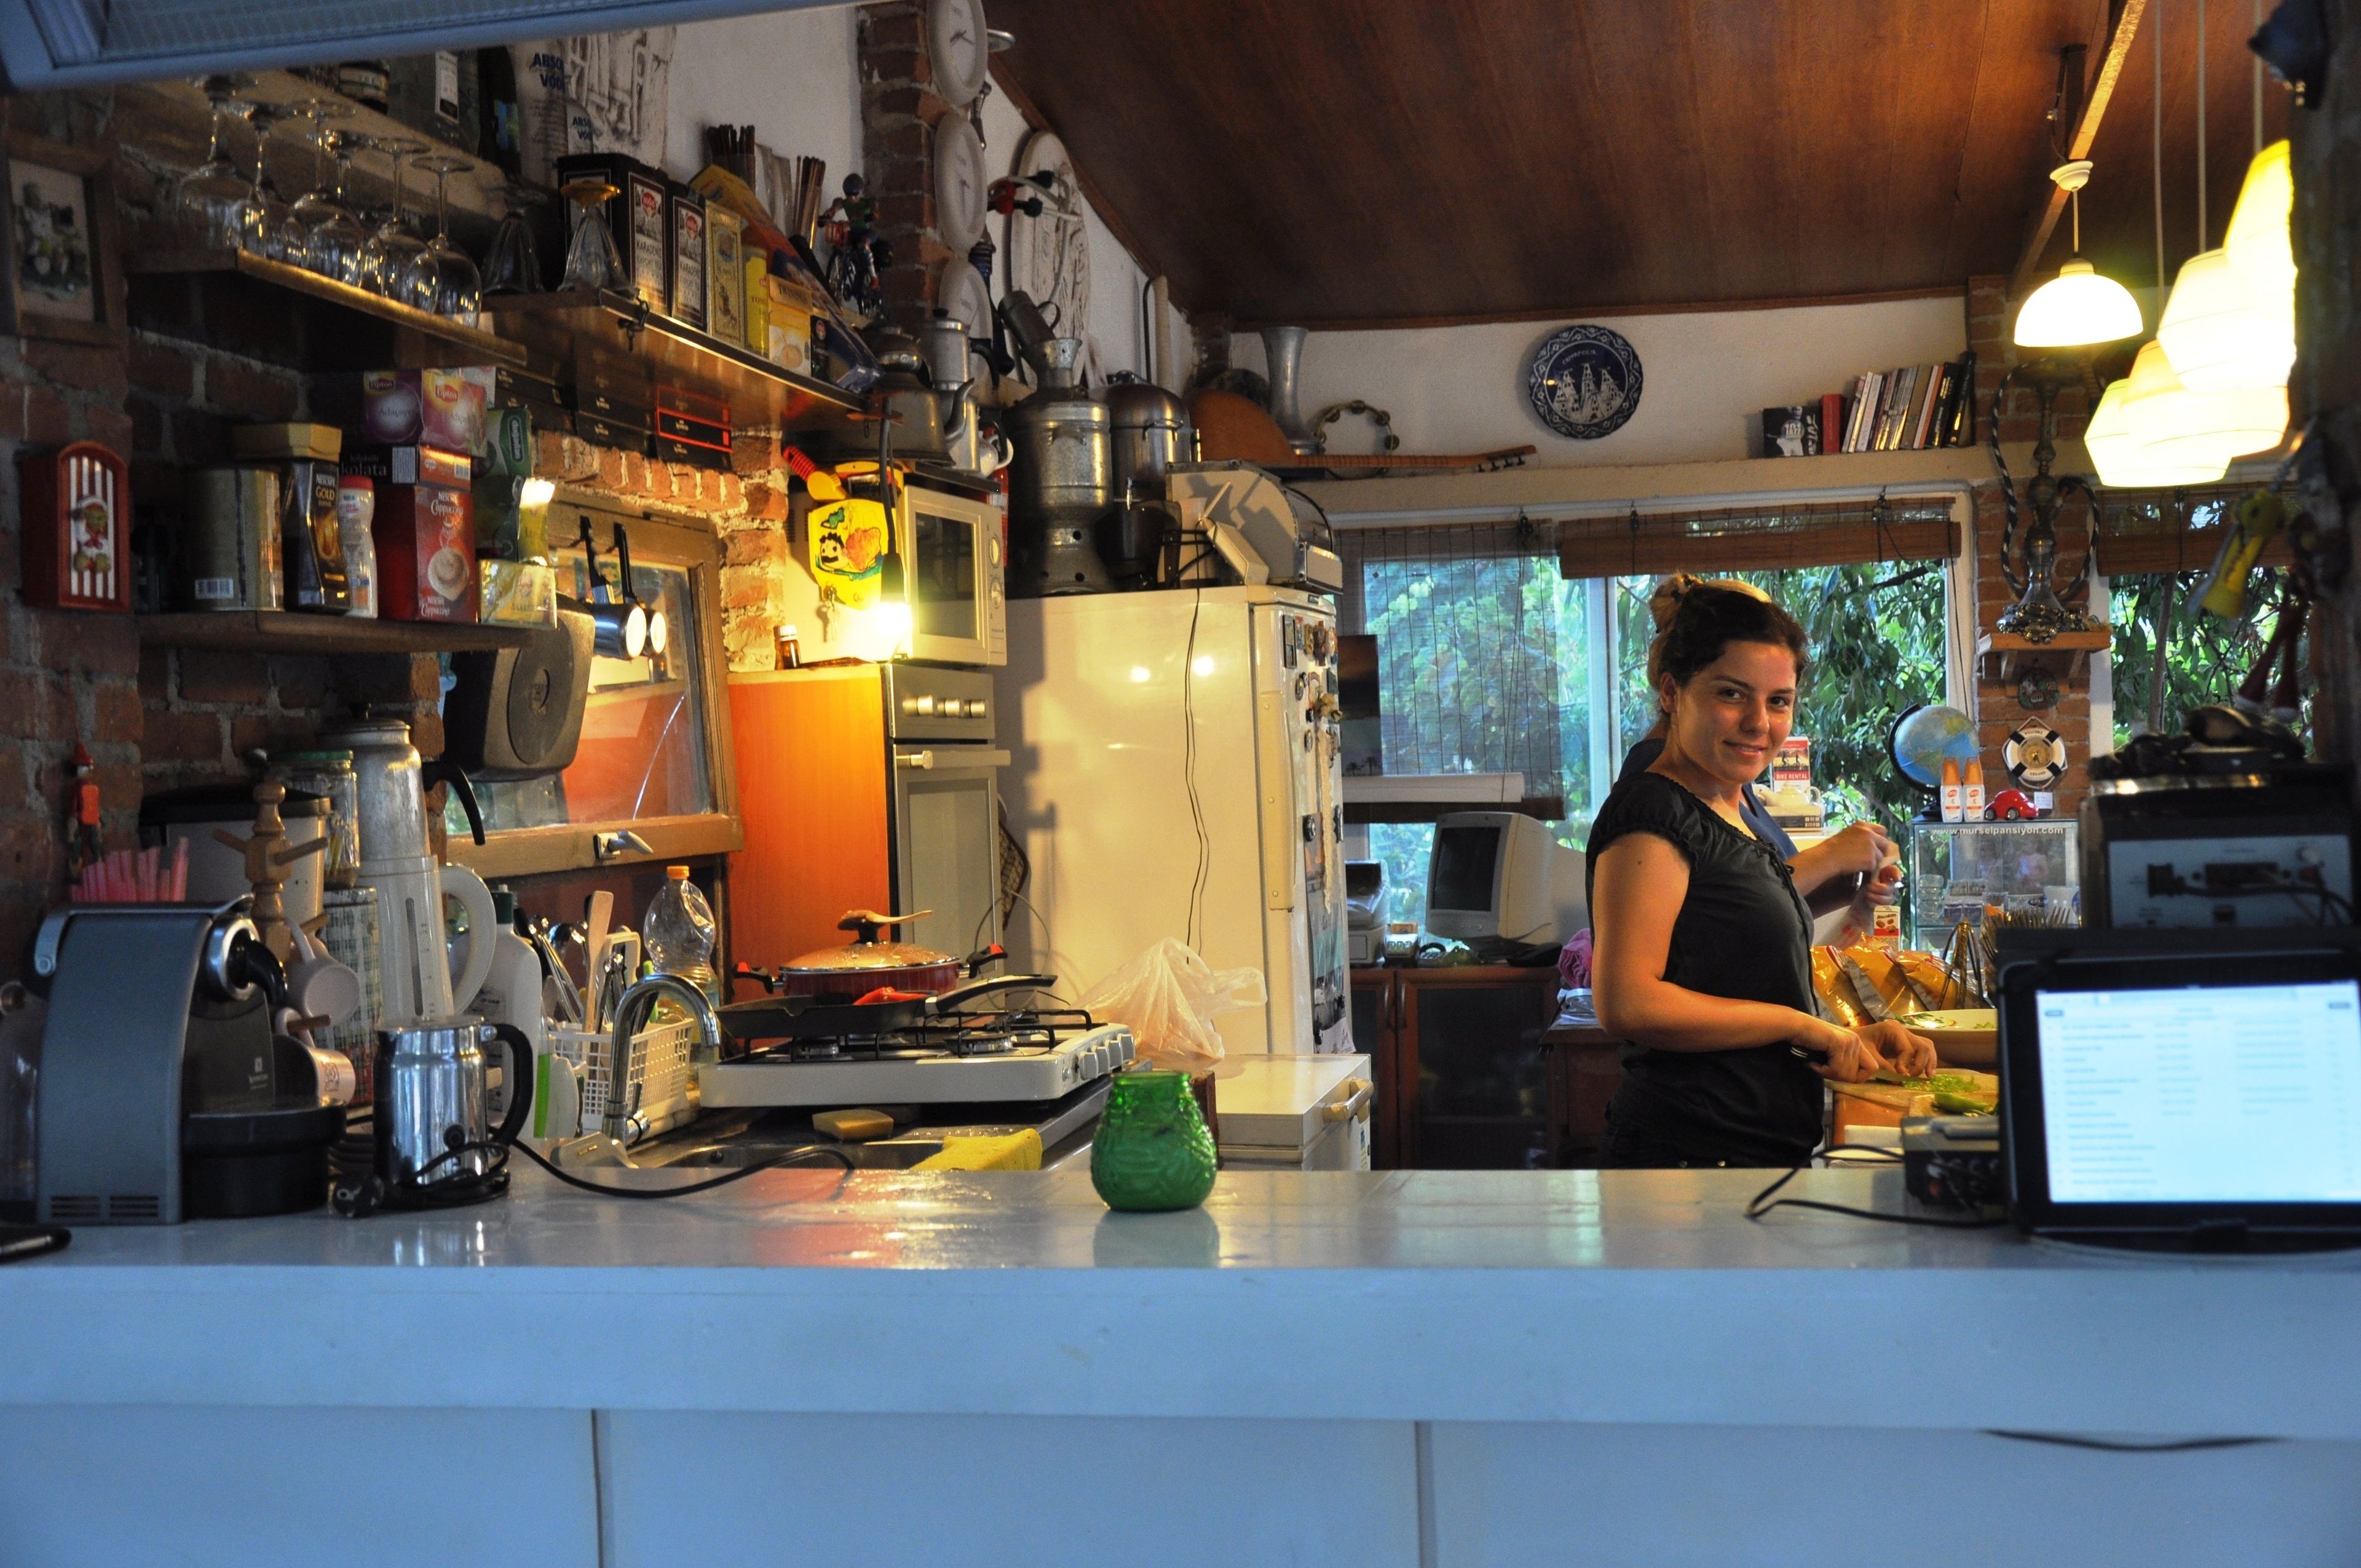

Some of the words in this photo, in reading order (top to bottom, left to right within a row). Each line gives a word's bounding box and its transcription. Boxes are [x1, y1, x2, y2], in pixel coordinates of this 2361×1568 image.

[532, 53, 564, 72] ABSO
[540, 74, 564, 92] VOD
[370, 379, 394, 390] Lipton
[436, 386, 457, 400] Lipton
[341, 462, 387, 477] kolata
[315, 487, 335, 502] GOLD
[430, 500, 464, 517] Cappuccino
